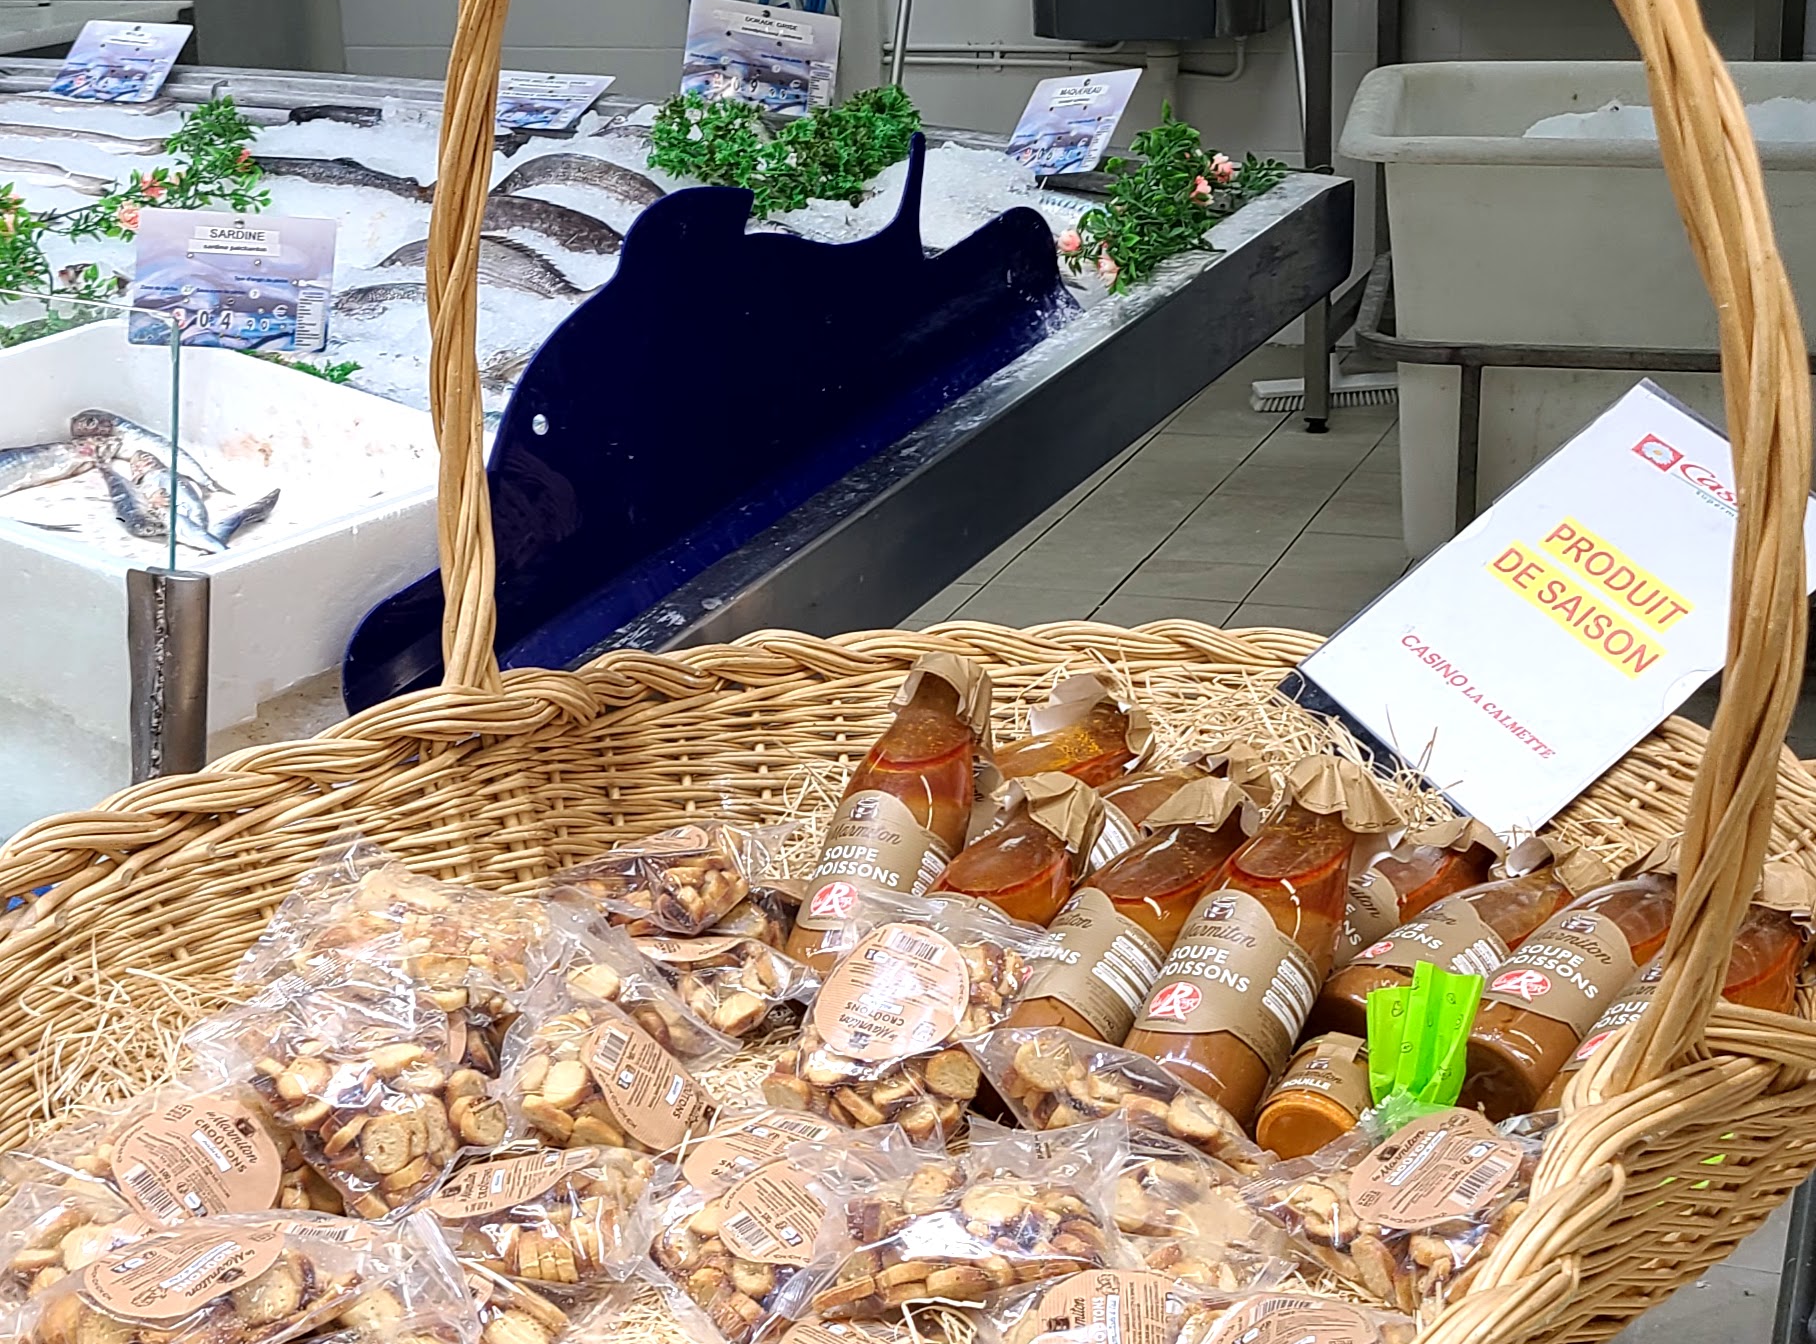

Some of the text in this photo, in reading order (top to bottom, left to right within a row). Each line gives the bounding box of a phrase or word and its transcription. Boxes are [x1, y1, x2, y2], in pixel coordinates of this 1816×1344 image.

[209, 228, 266, 242] SARDINE
[1680, 463, 1739, 507] Cas
[1544, 523, 1689, 624] PRODUIT
[1493, 547, 1660, 673] DE SAISON
[1401, 634, 1557, 759] CASINO LA CALMETTE
[823, 845, 880, 863] SOUPE
[1169, 945, 1230, 964] SOUPE
[1518, 944, 1585, 968] SOUPE
[845, 1001, 905, 1027] CROÛTONS
[1281, 1077, 1332, 1091] ROUILLE
[194, 1118, 247, 1174] CROÛTONS
[211, 1114, 258, 1164] Marmiton
[1380, 1129, 1426, 1178] Marmiton
[185, 1250, 248, 1298] Marmiton
